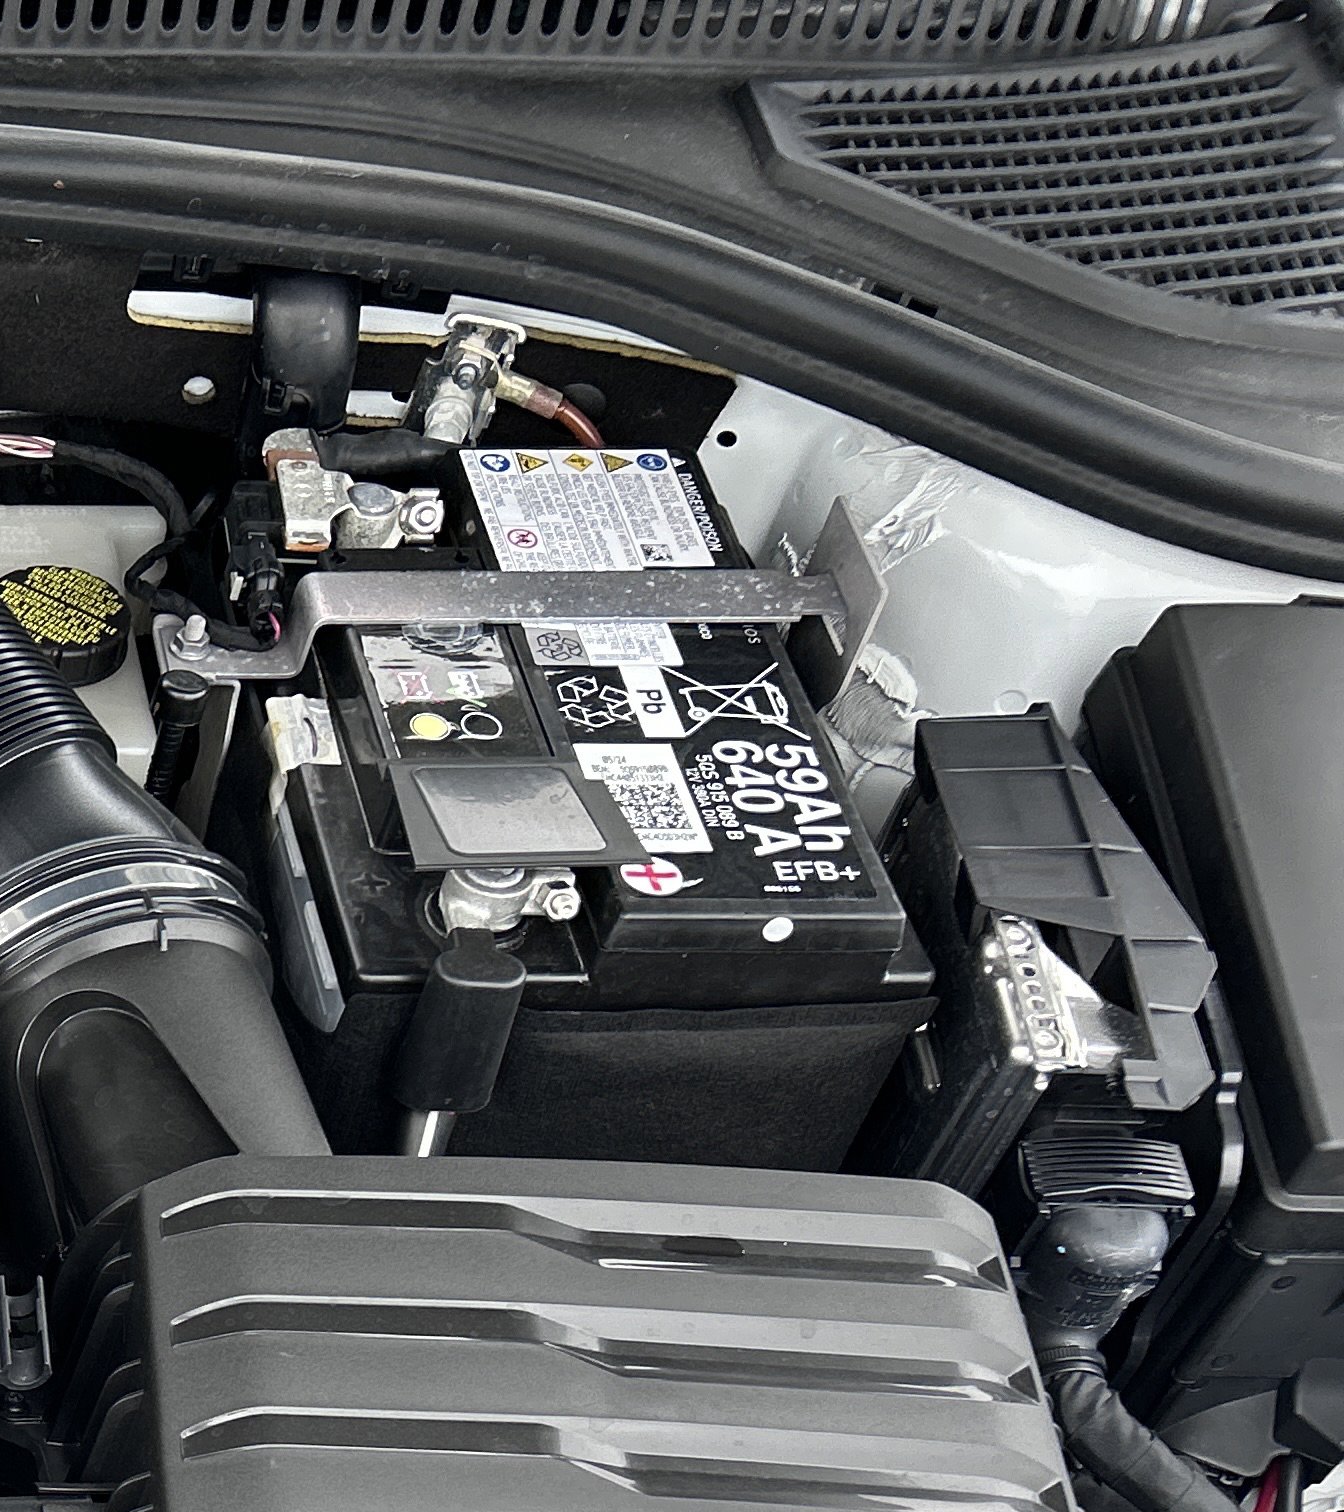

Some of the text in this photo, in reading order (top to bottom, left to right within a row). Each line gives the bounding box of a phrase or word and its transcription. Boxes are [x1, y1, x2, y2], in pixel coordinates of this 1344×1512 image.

[676, 472, 723, 553] DANGER/POISON
[636, 689, 667, 714] Pb
[712, 740, 785, 814] 640
[706, 781, 730, 803] 915
[764, 743, 852, 852] 59Ah
[701, 808, 721, 828] DIN
[714, 805, 740, 828] 089
[724, 830, 745, 841] B
[744, 823, 803, 857] A
[772, 860, 862, 882] EFB+
